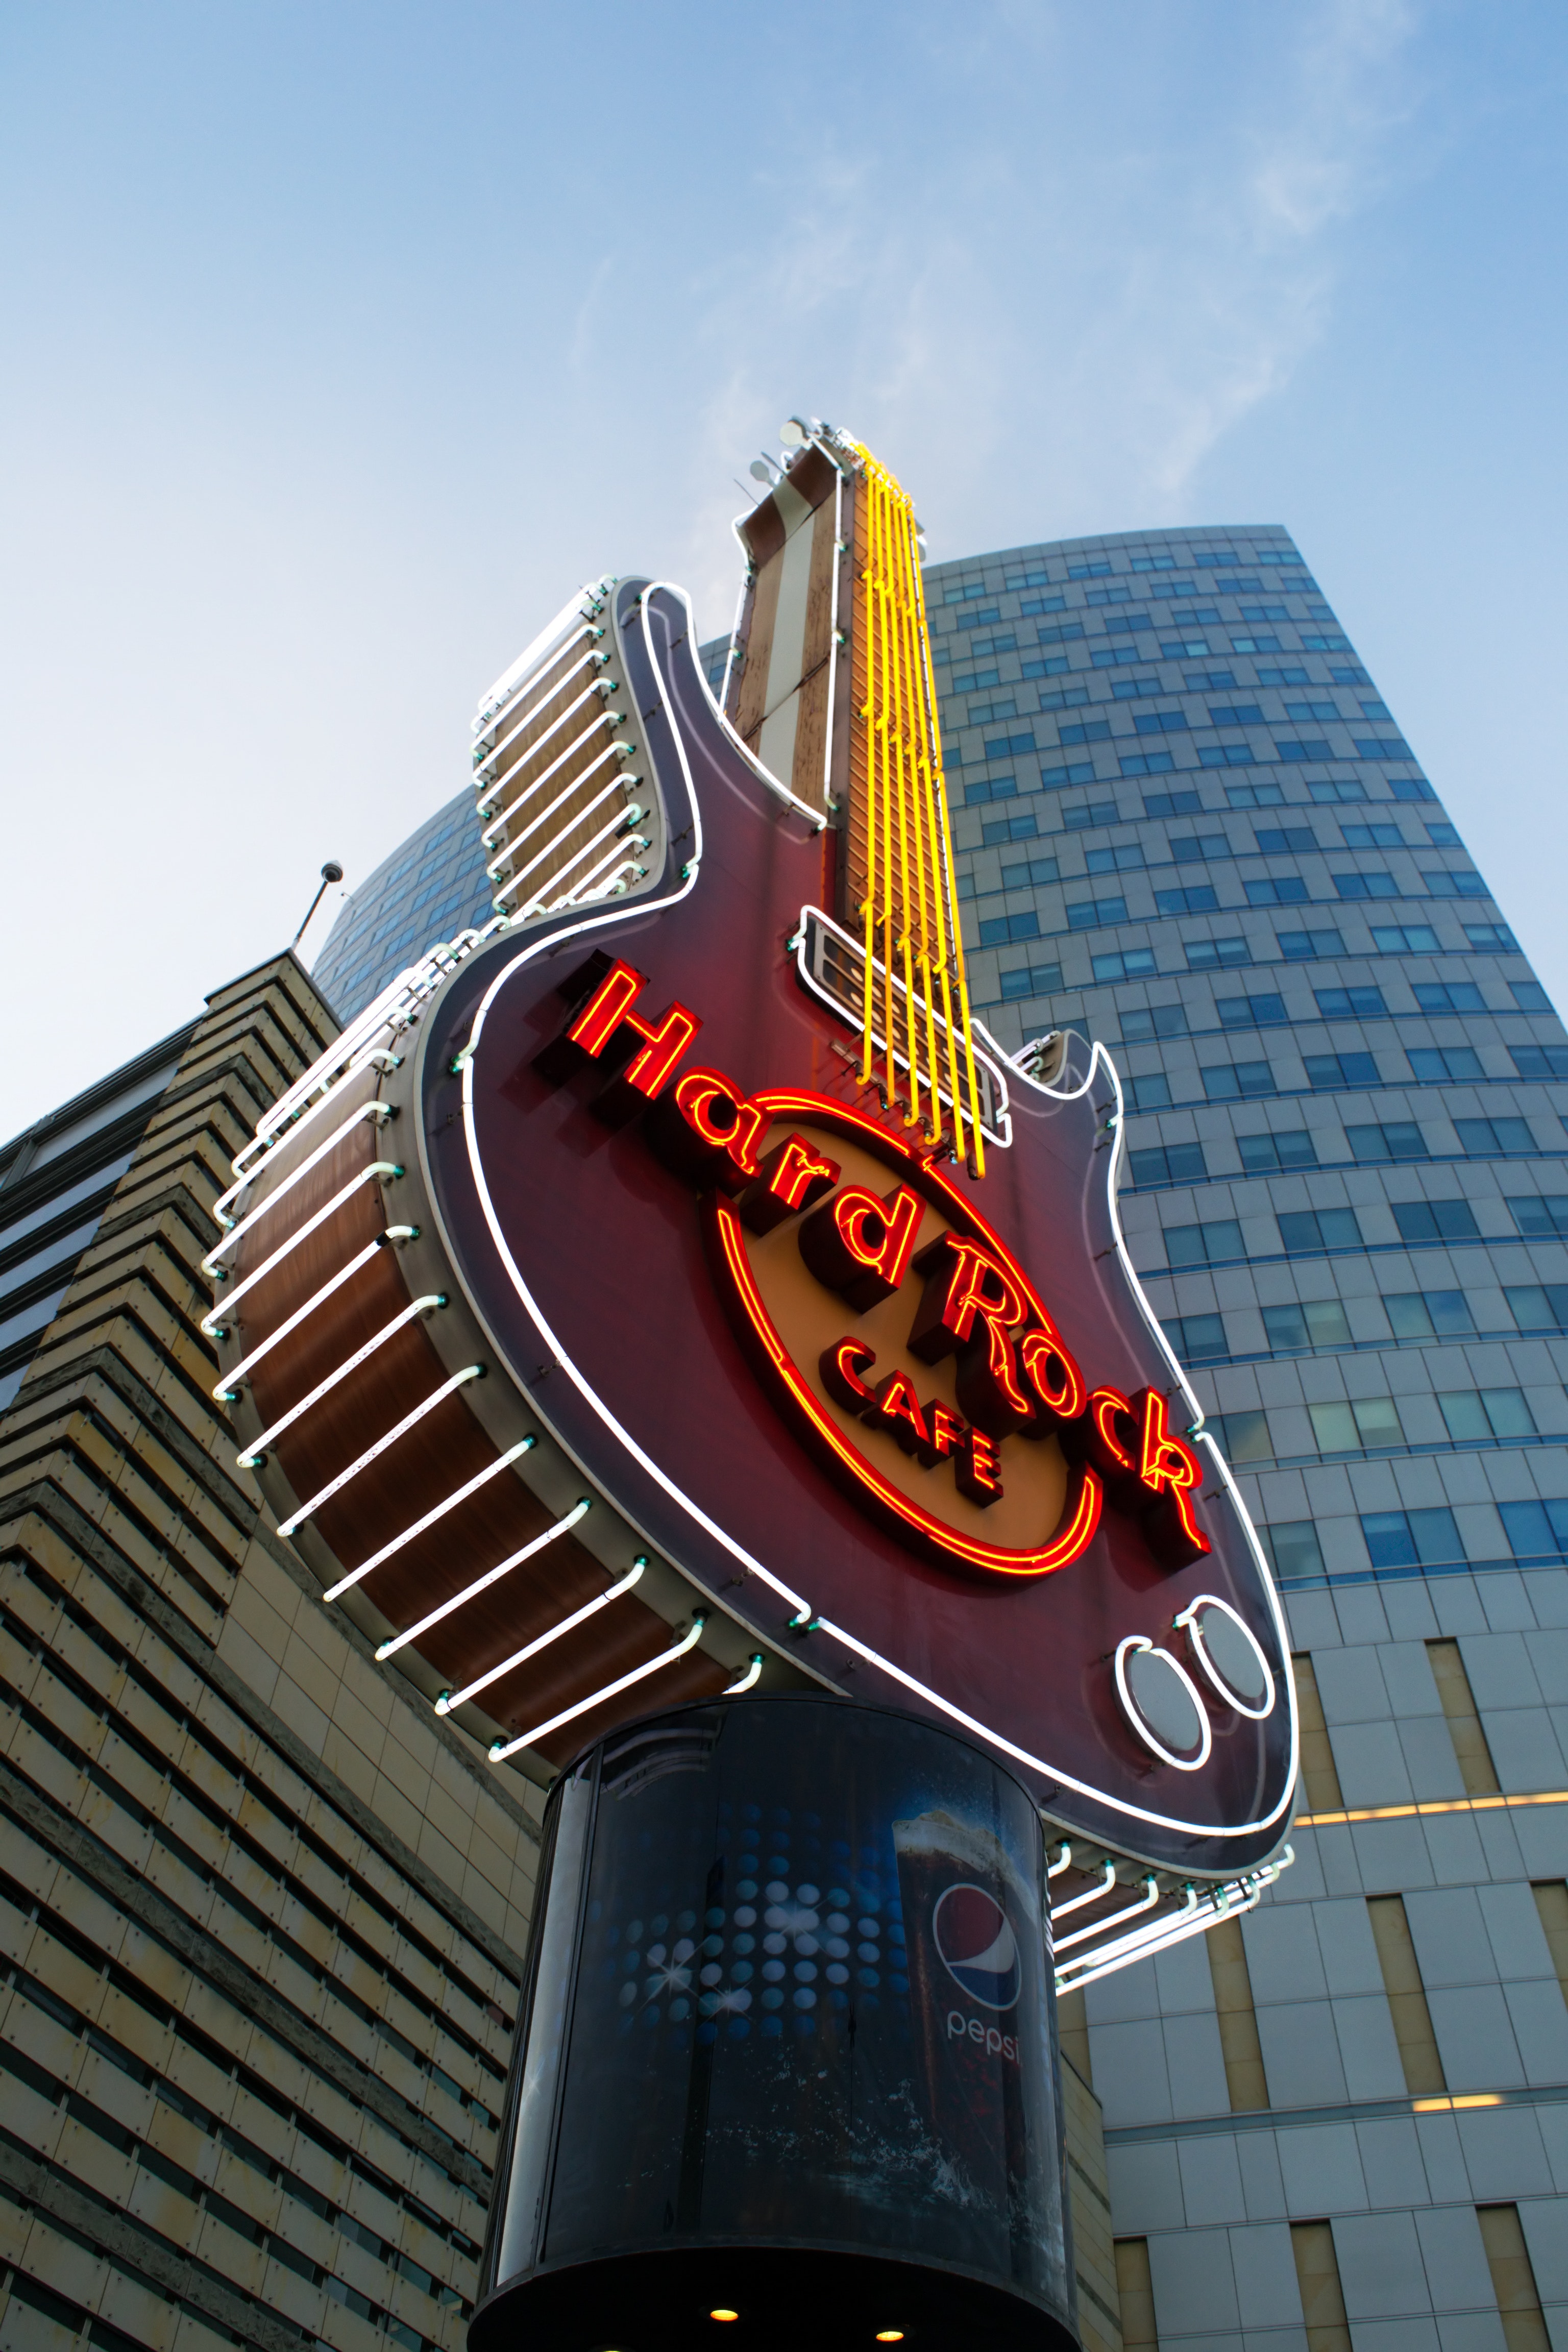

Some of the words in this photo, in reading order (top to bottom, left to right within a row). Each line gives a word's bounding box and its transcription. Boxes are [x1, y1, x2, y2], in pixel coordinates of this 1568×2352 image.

[566, 958, 926, 1289] Hard
[941, 1230, 1212, 1553] Rock
[837, 1336, 1003, 1498] CAFE
[947, 2010, 1020, 2065] pepsi
